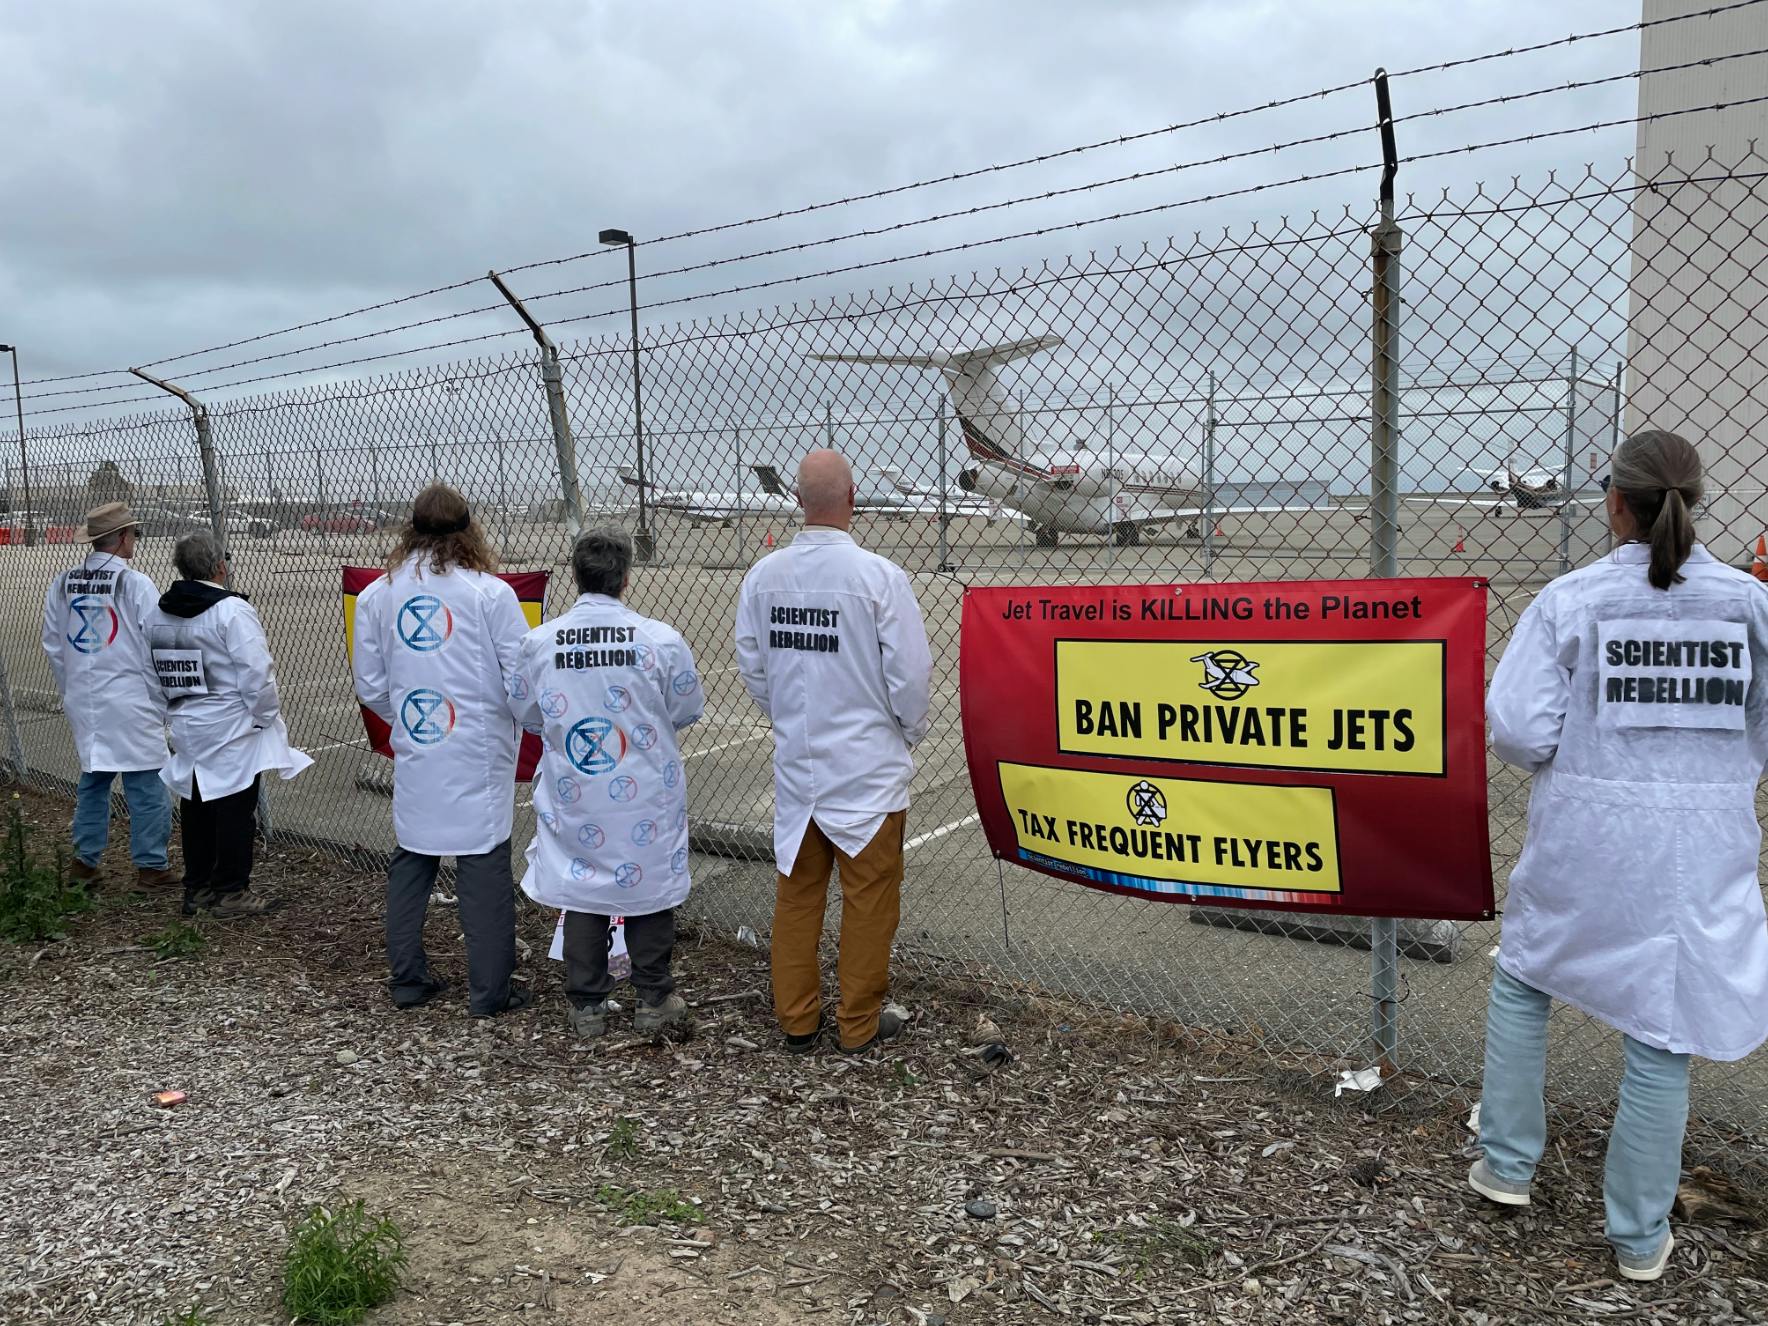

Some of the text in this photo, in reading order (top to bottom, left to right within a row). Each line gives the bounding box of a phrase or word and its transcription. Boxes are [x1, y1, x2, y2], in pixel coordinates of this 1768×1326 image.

[67, 583, 112, 594] REBELLION
[771, 606, 840, 628] SCIENTIST
[1002, 596, 1422, 621] Jet Travel is KILLING the Planet
[556, 626, 636, 646] SCIENTIST
[769, 630, 839, 652] REBELLION
[555, 649, 636, 669] REBELLION
[1606, 640, 1744, 668] SCIENTIST
[1606, 677, 1744, 706] REBELLION
[1075, 699, 1415, 752] BAN PRIVATE JETS
[1017, 808, 1323, 872] TAX FREQUENT FLYERS
